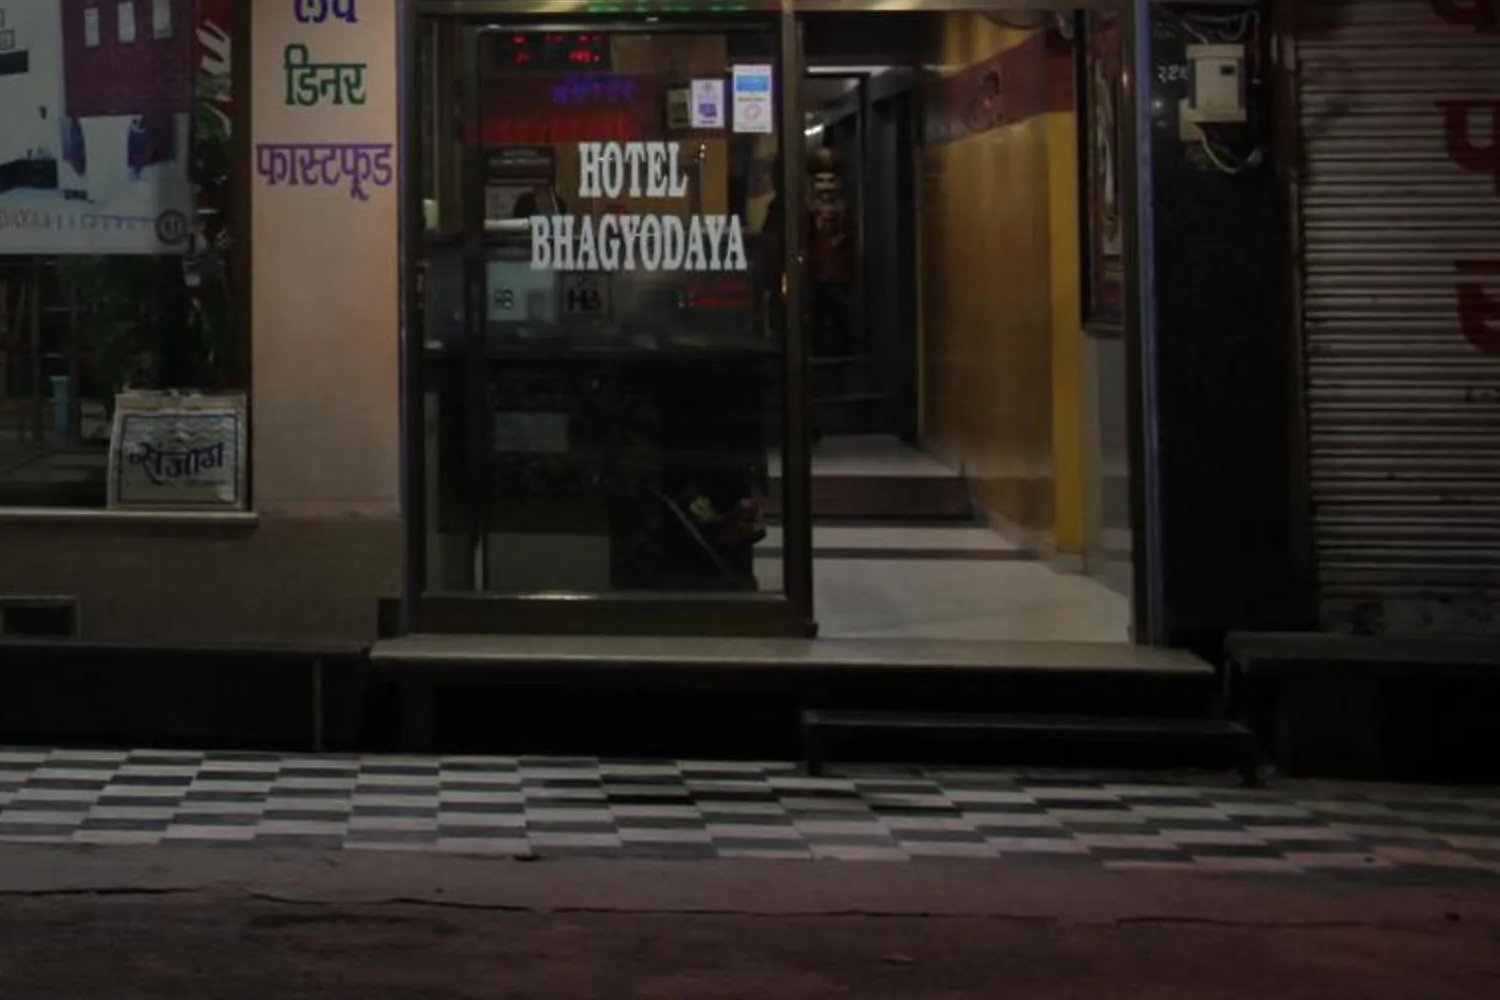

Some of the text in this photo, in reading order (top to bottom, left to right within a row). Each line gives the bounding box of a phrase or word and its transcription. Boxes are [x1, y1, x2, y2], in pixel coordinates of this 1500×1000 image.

[284, 43, 366, 106] डिनर
[256, 144, 393, 200] फास्टफूड
[578, 141, 688, 198] HOTEL
[530, 213, 748, 272] BHAGYODAYA
